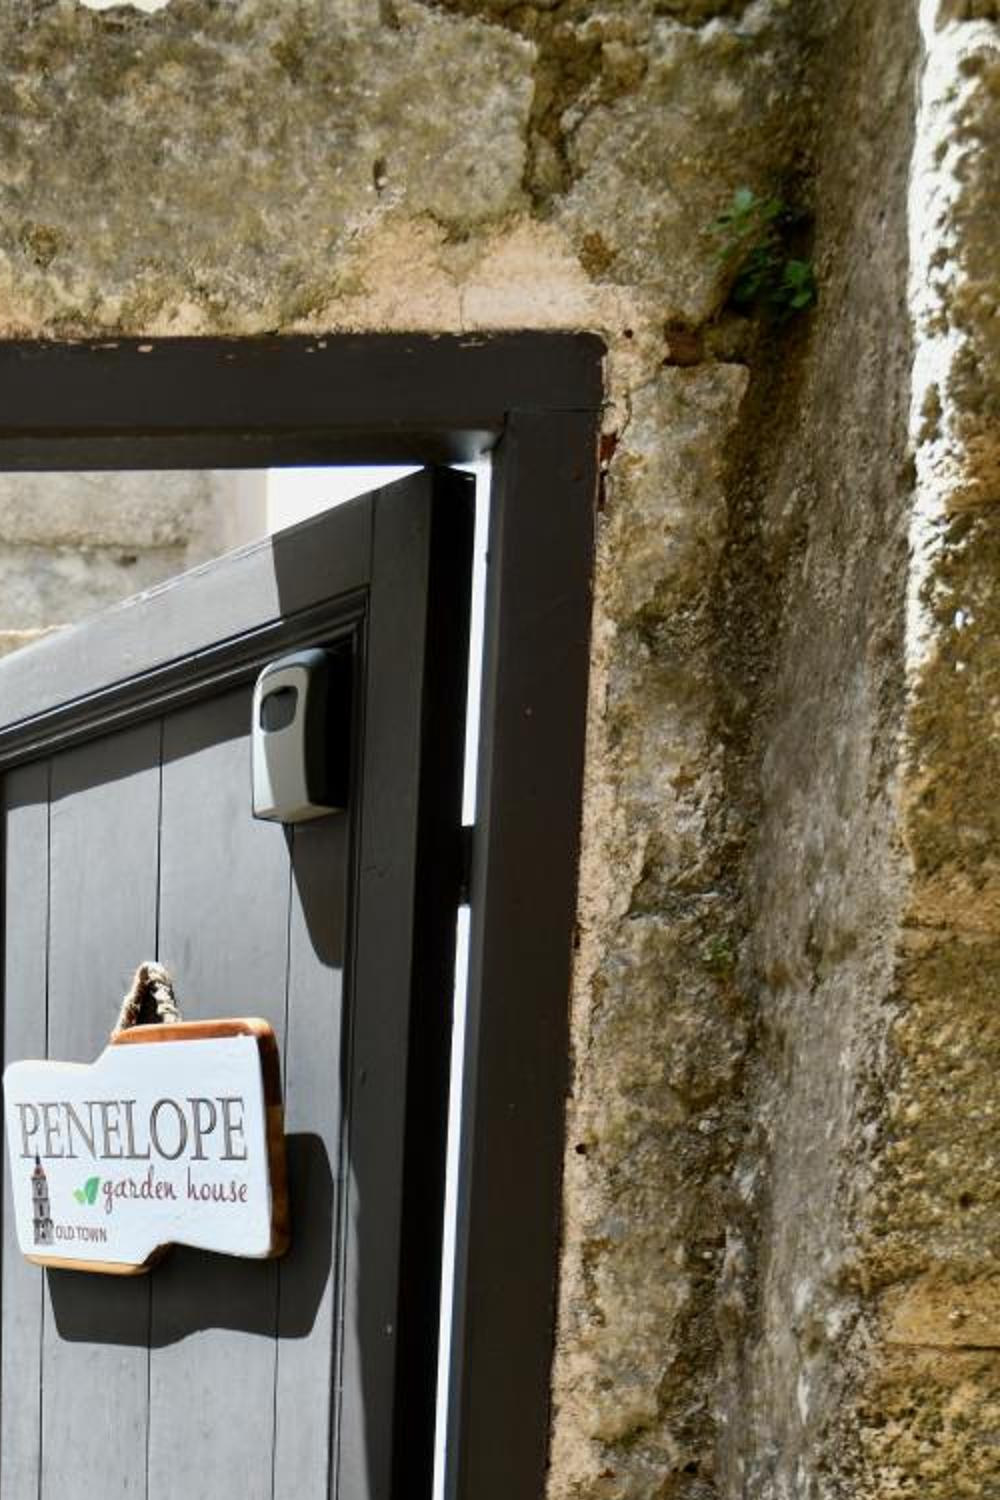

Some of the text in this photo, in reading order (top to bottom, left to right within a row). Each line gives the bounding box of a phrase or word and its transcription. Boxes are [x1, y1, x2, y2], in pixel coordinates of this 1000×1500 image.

[14, 1097, 248, 1161] PENELOPE
[102, 1165, 248, 1214] garden house
[55, 1225, 107, 1243] OLD TOWN
